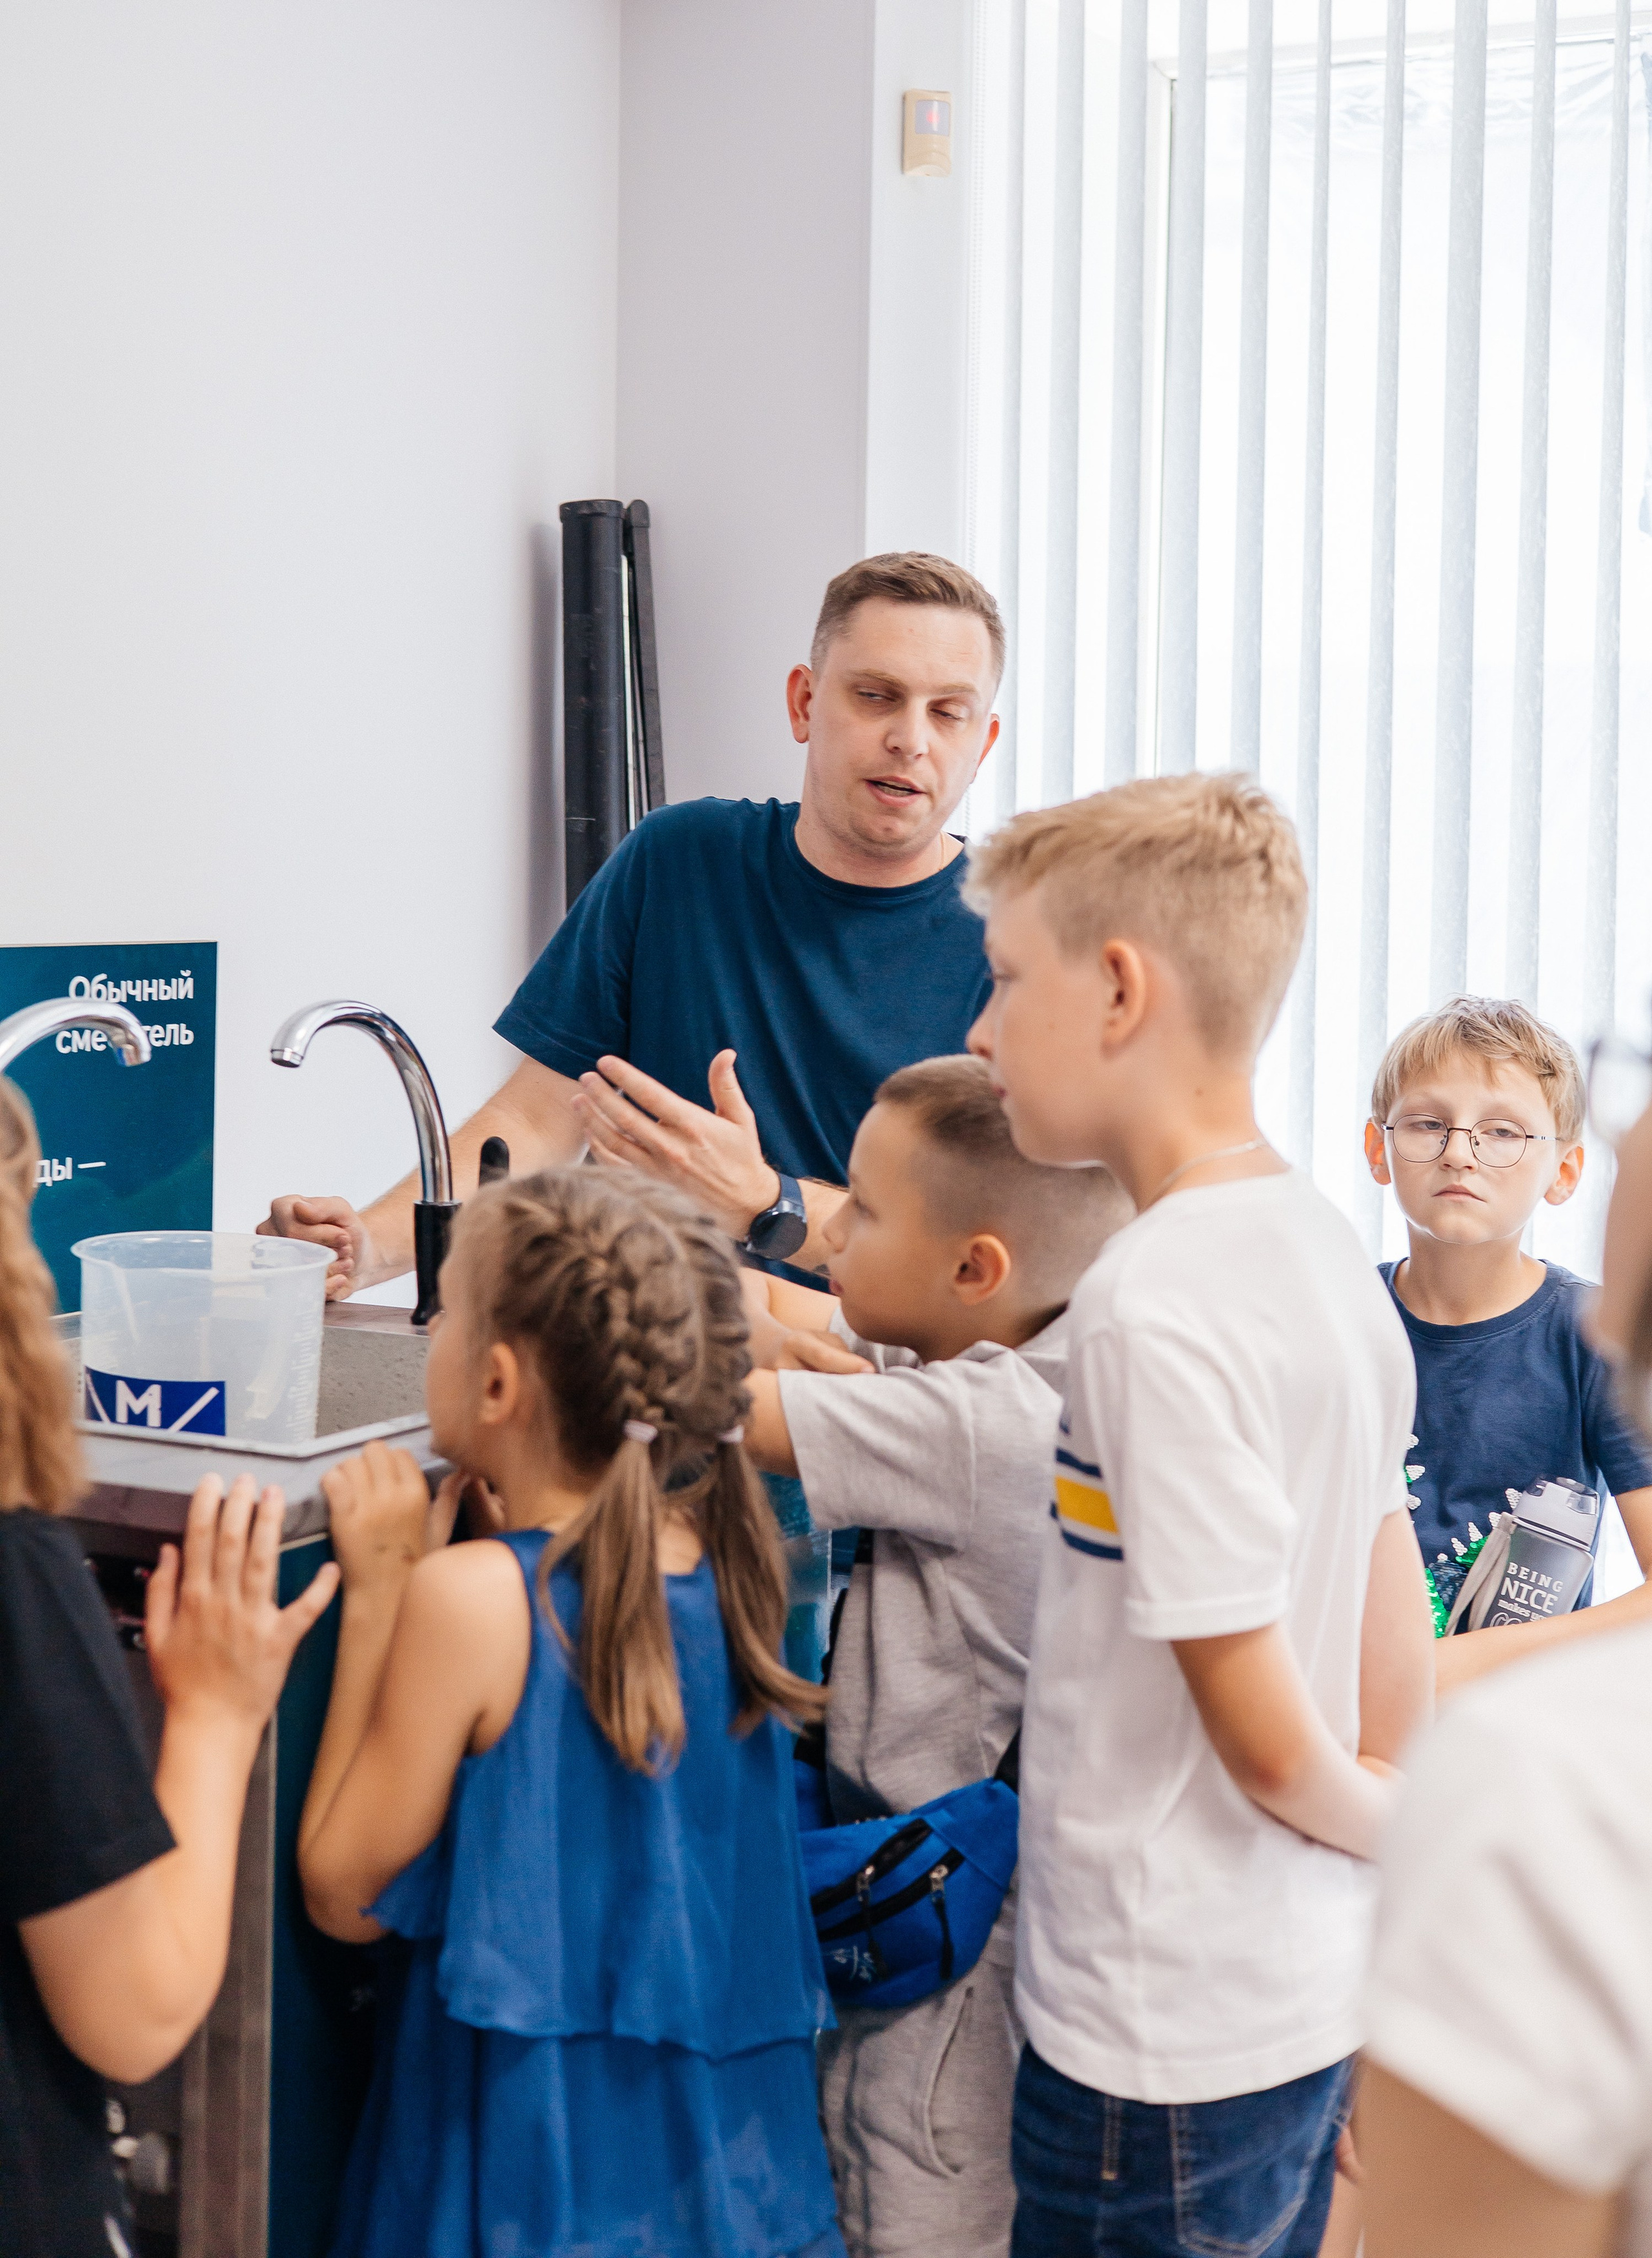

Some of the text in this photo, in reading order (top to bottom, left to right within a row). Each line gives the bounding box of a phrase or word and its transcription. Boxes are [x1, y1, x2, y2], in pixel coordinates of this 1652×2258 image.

[68, 969, 194, 1003] Обычный
[55, 1023, 194, 1054] смеель
[1507, 1562, 1564, 1593] BEING
[1497, 1599, 1531, 1617] makes
[1500, 1577, 1558, 1614] NICE
